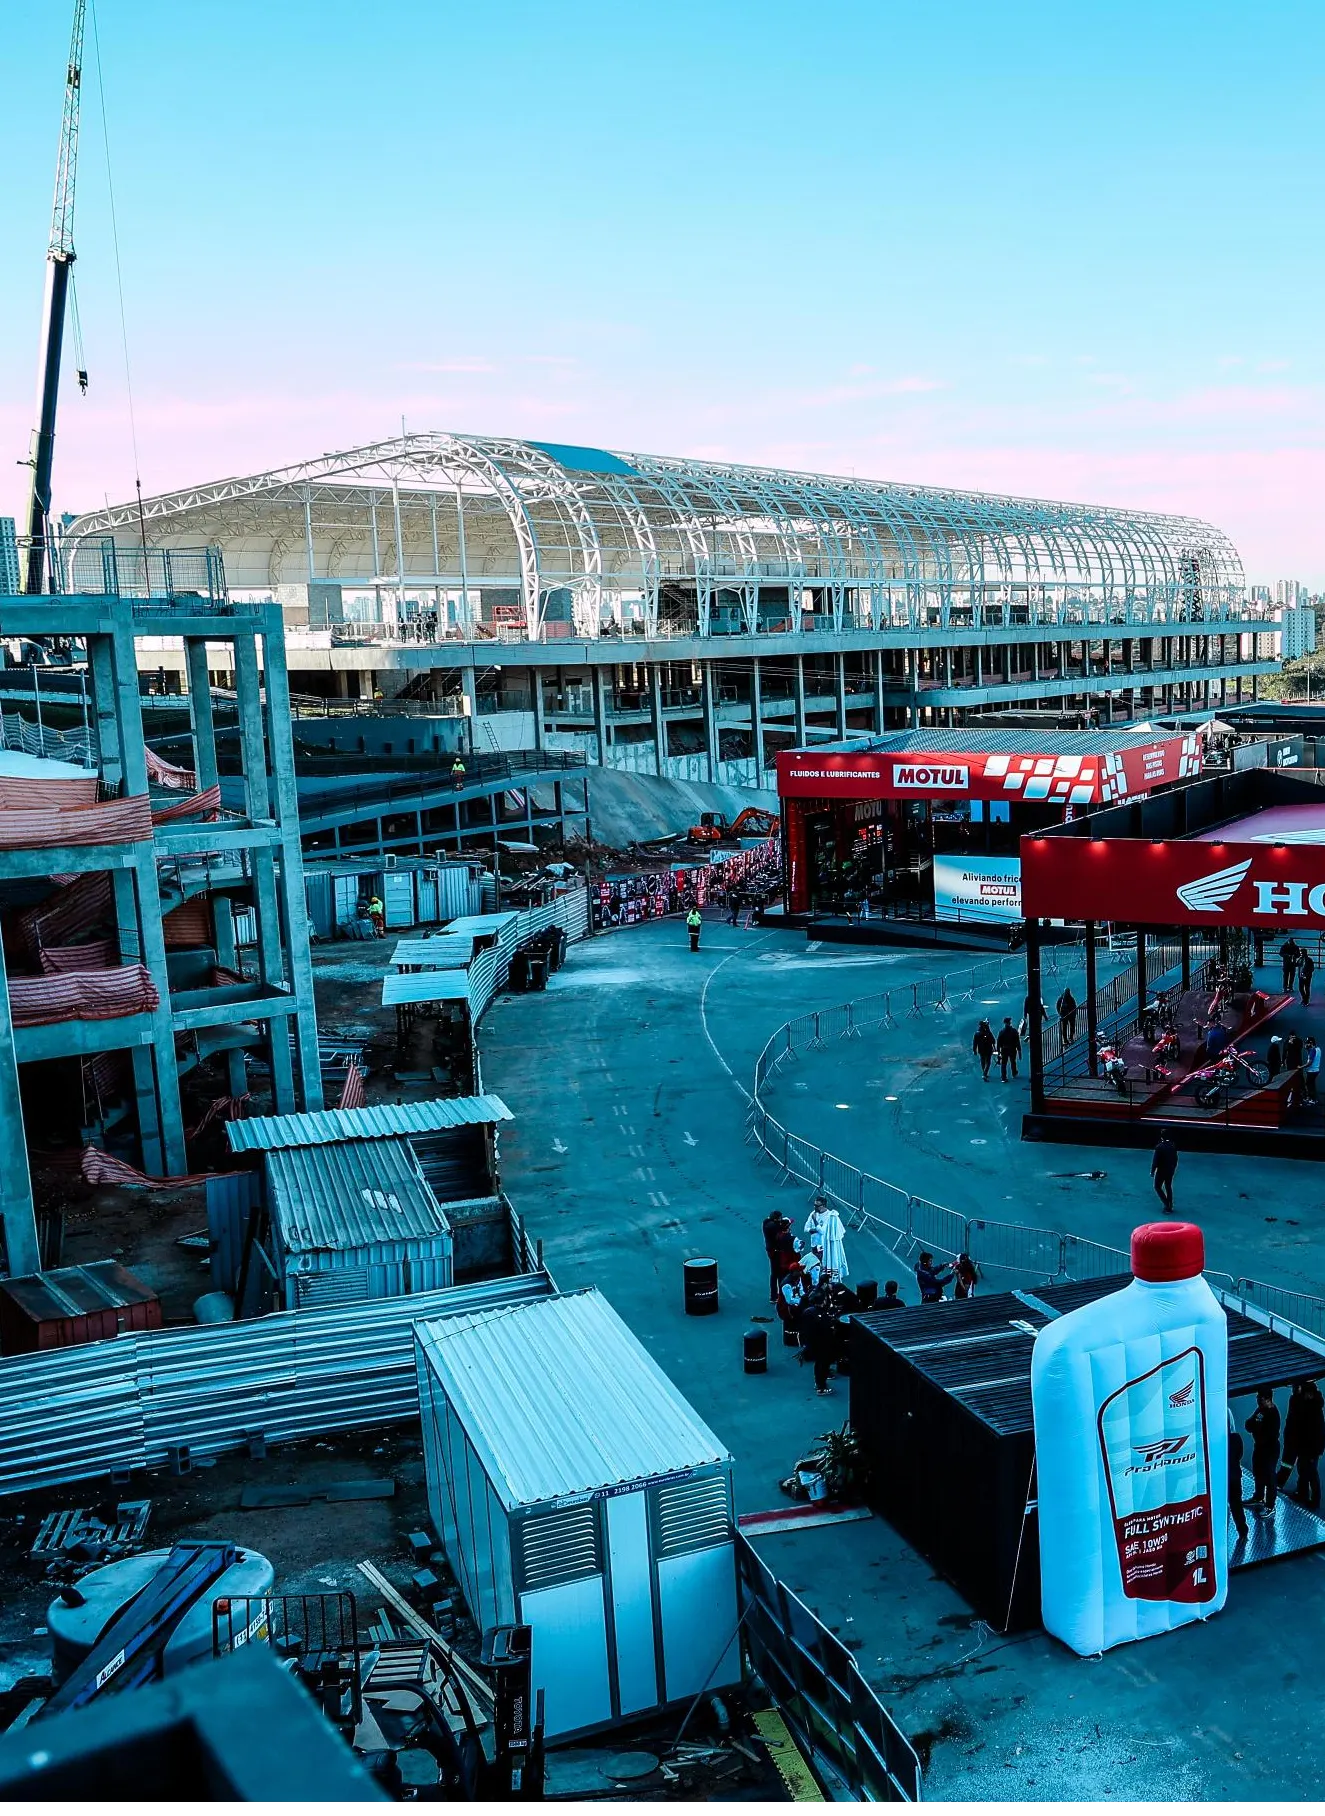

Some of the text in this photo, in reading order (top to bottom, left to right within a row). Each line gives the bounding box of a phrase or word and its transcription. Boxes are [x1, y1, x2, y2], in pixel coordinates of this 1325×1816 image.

[790, 770, 820, 778] FLUIDOS
[826, 771, 880, 779] LUBRIFICANTES
[897, 768, 965, 785] MOTUL
[855, 799, 882, 821] MOTU
[962, 873, 1003, 883] Aliviando
[981, 885, 1016, 895] MOTUL
[952, 896, 990, 906] elevando
[1169, 1398, 1196, 1409] HONDA
[1125, 1452, 1196, 1476] Pro Honda
[614, 1485, 630, 1494] 2198
[631, 1481, 647, 1491] 2066
[1125, 1506, 1203, 1539] FULL SYNTHETIC
[1125, 1533, 1168, 1554] SAE 10W30
[1193, 1567, 1207, 1587] 1L
[513, 1696, 523, 1735] TOYOTA
